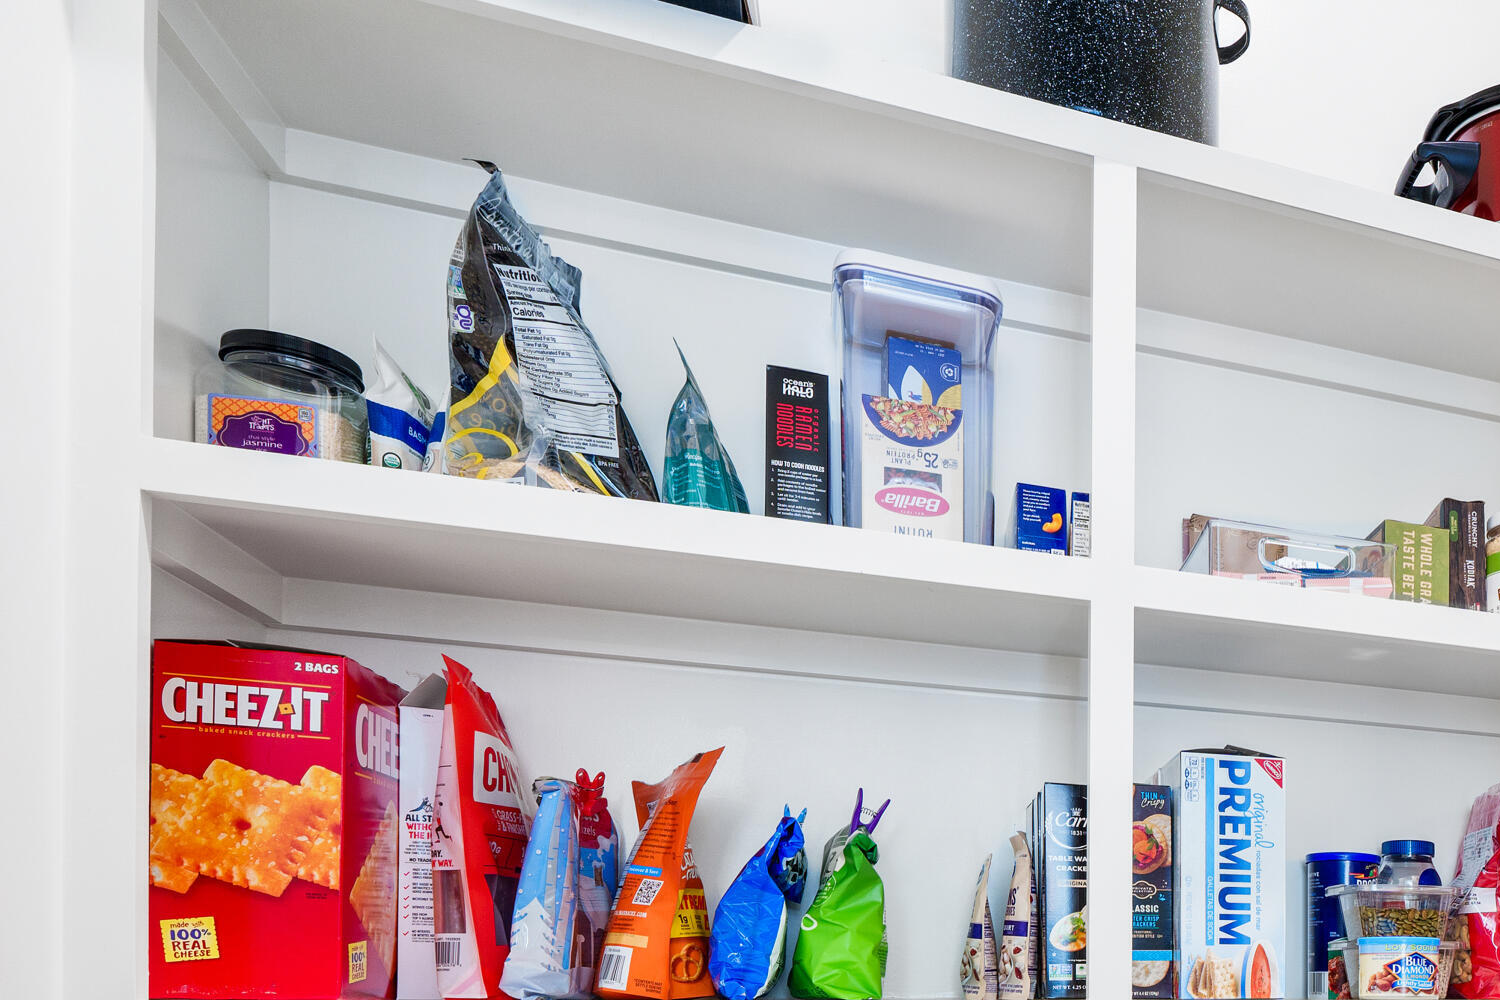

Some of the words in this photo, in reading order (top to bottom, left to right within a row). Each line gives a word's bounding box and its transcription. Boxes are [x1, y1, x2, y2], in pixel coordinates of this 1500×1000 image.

[513, 307, 544, 318] Calories
[776, 403, 794, 448] NOODLES
[884, 492, 941, 513] Barilla
[1402, 530, 1415, 571] TASTE
[1420, 533, 1432, 578] WHOLE
[1465, 559, 1475, 588] KODIAK
[294, 662, 302, 671] 2
[305, 663, 339, 674] BAGS
[257, 731, 295, 740] crackers
[1141, 791, 1158, 799] THIN
[1141, 797, 1165, 809] Crispy
[405, 814, 420, 822] ALL
[1253, 792, 1275, 850] original
[409, 831, 425, 839] THE
[1218, 759, 1251, 945] PREMIUM
[170, 921, 189, 929] made
[170, 928, 212, 941] 100%
[172, 940, 210, 951] REAL
[174, 950, 211, 959] CHEESE
[1406, 956, 1427, 966] BLUE
[1392, 964, 1435, 975] DIAMOND
